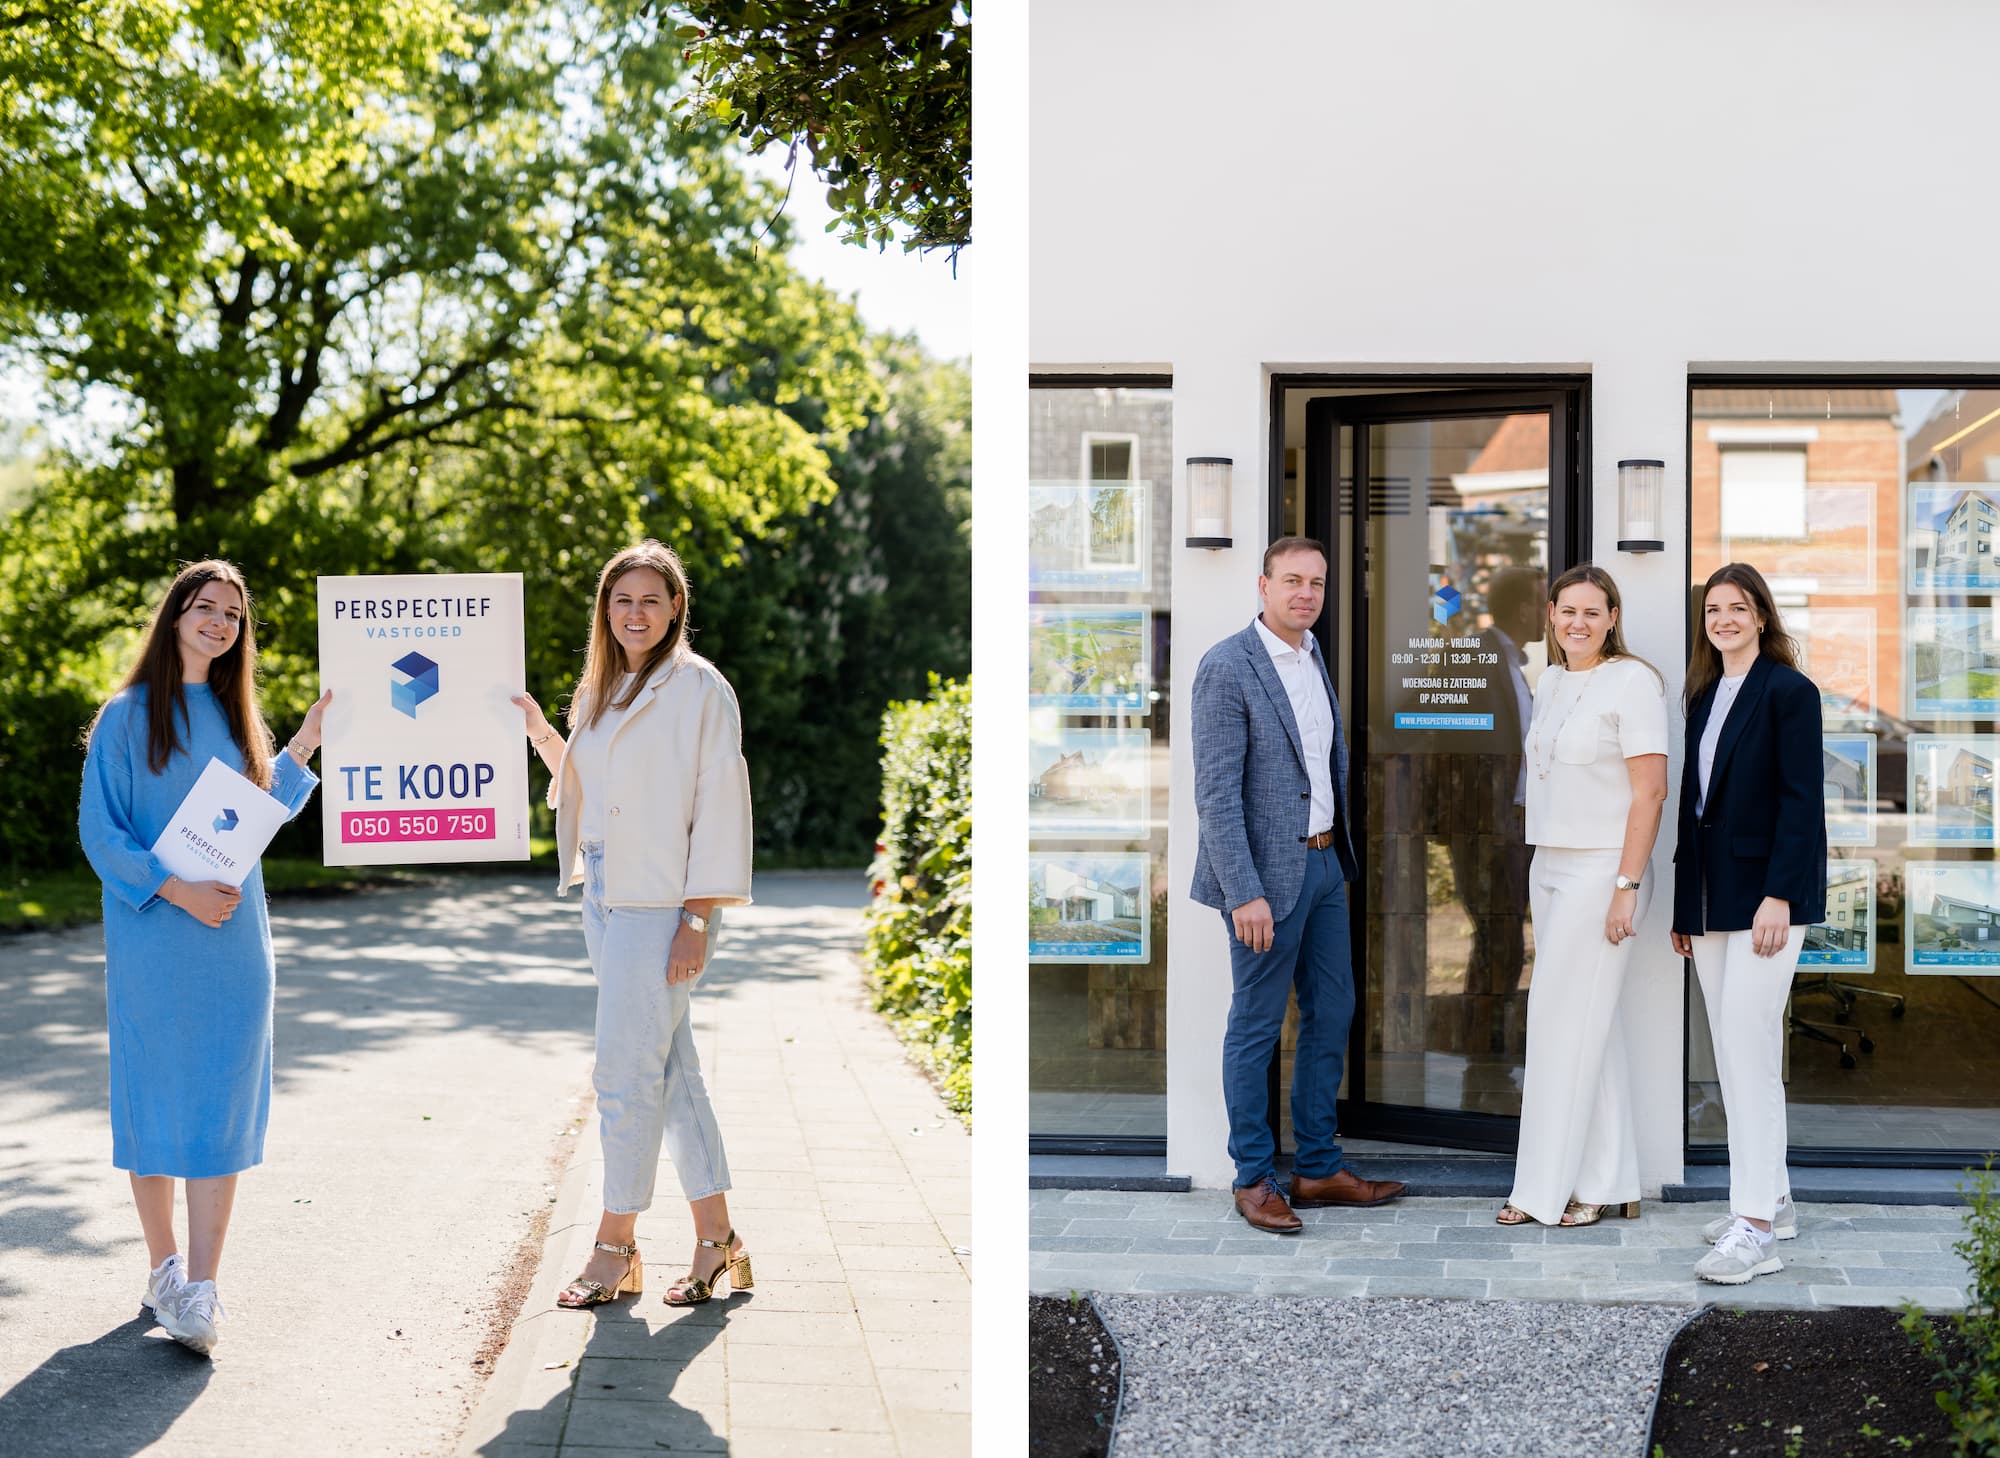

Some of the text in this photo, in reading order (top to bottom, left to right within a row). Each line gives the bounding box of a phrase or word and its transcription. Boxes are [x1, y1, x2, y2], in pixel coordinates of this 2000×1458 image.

[335, 598, 491, 620] PERSPECTIEF
[366, 626, 462, 639] VASTGOED
[1409, 638, 1445, 649] MAANDAG
[1450, 638, 1481, 649] VRIJDAG
[1392, 653, 1414, 664] 09:00
[1420, 653, 1441, 664] 12:30
[1450, 653, 1471, 664] 13:30
[1478, 653, 1498, 664] 17:30
[1402, 677, 1487, 689] WOENSDAG & ZATERDAG
[1419, 693, 1469, 705] OP AFSPRAAK
[339, 763, 495, 801] TE KOOP
[350, 814, 487, 837] 050 550 750
[180, 826, 237, 868] PERSPECTIEF
